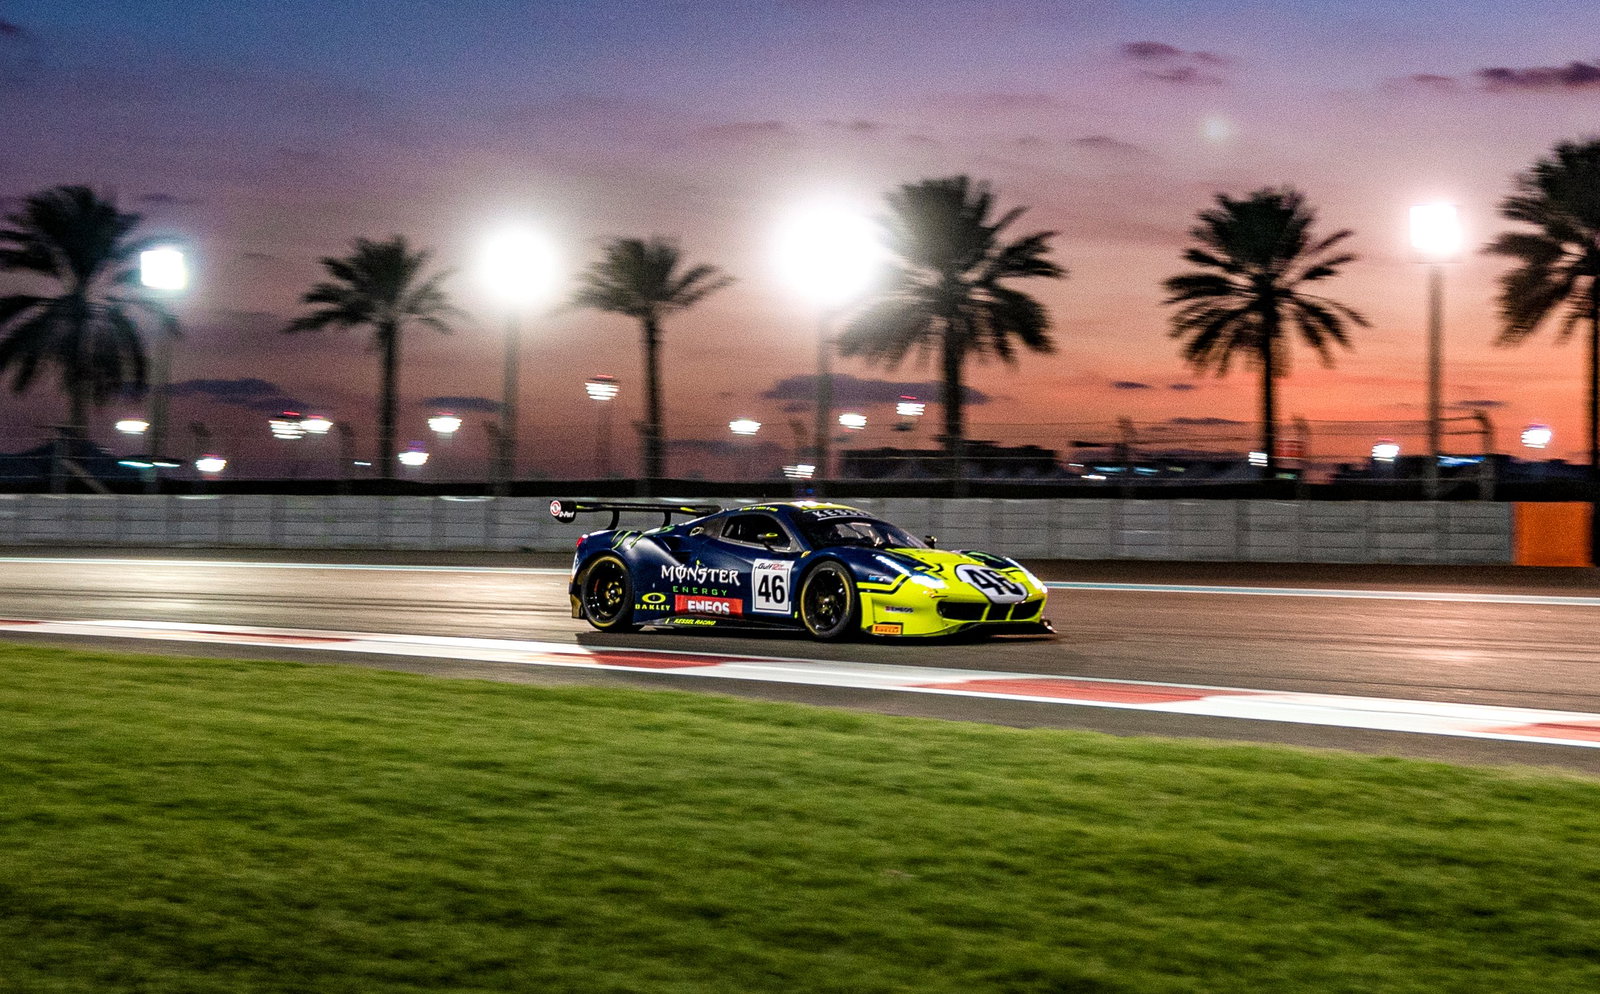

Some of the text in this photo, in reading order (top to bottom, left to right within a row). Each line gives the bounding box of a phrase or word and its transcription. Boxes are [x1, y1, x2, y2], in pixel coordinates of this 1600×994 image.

[672, 585, 728, 596] ENERGY
[758, 575, 785, 604] 46
[635, 603, 671, 611] OAKLEY
[687, 600, 730, 615] ENEOS
